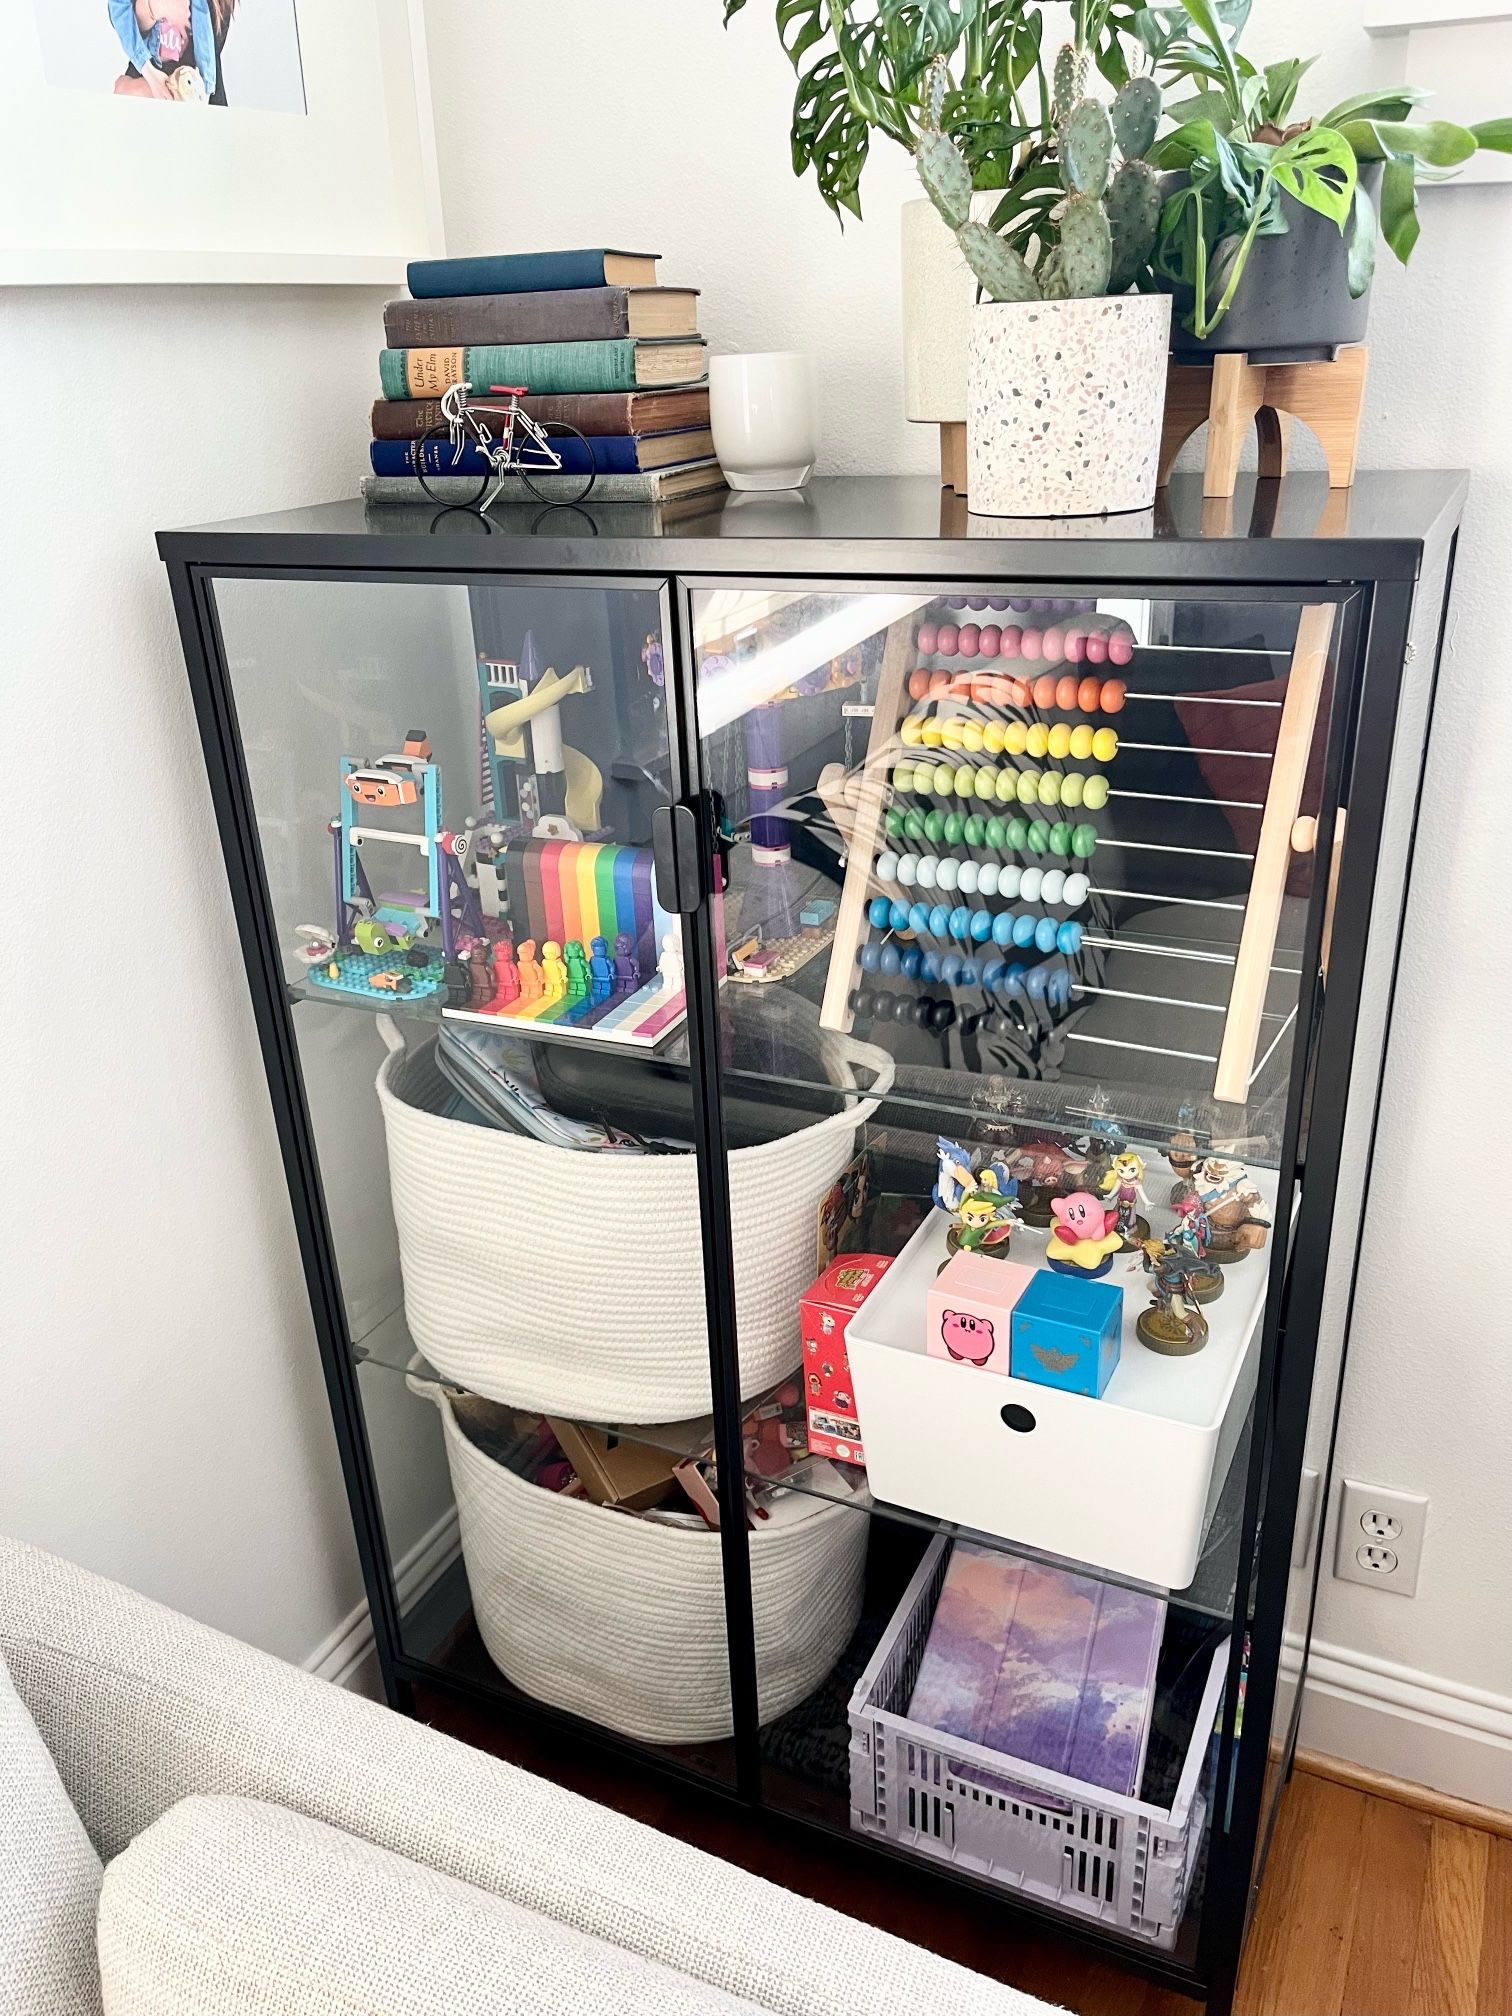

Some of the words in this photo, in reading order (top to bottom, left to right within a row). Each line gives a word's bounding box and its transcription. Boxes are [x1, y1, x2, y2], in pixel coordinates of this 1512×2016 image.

[426, 353, 437, 372] Elm
[414, 358, 425, 388] Under
[428, 374, 440, 392] My
[415, 409, 424, 428] The
